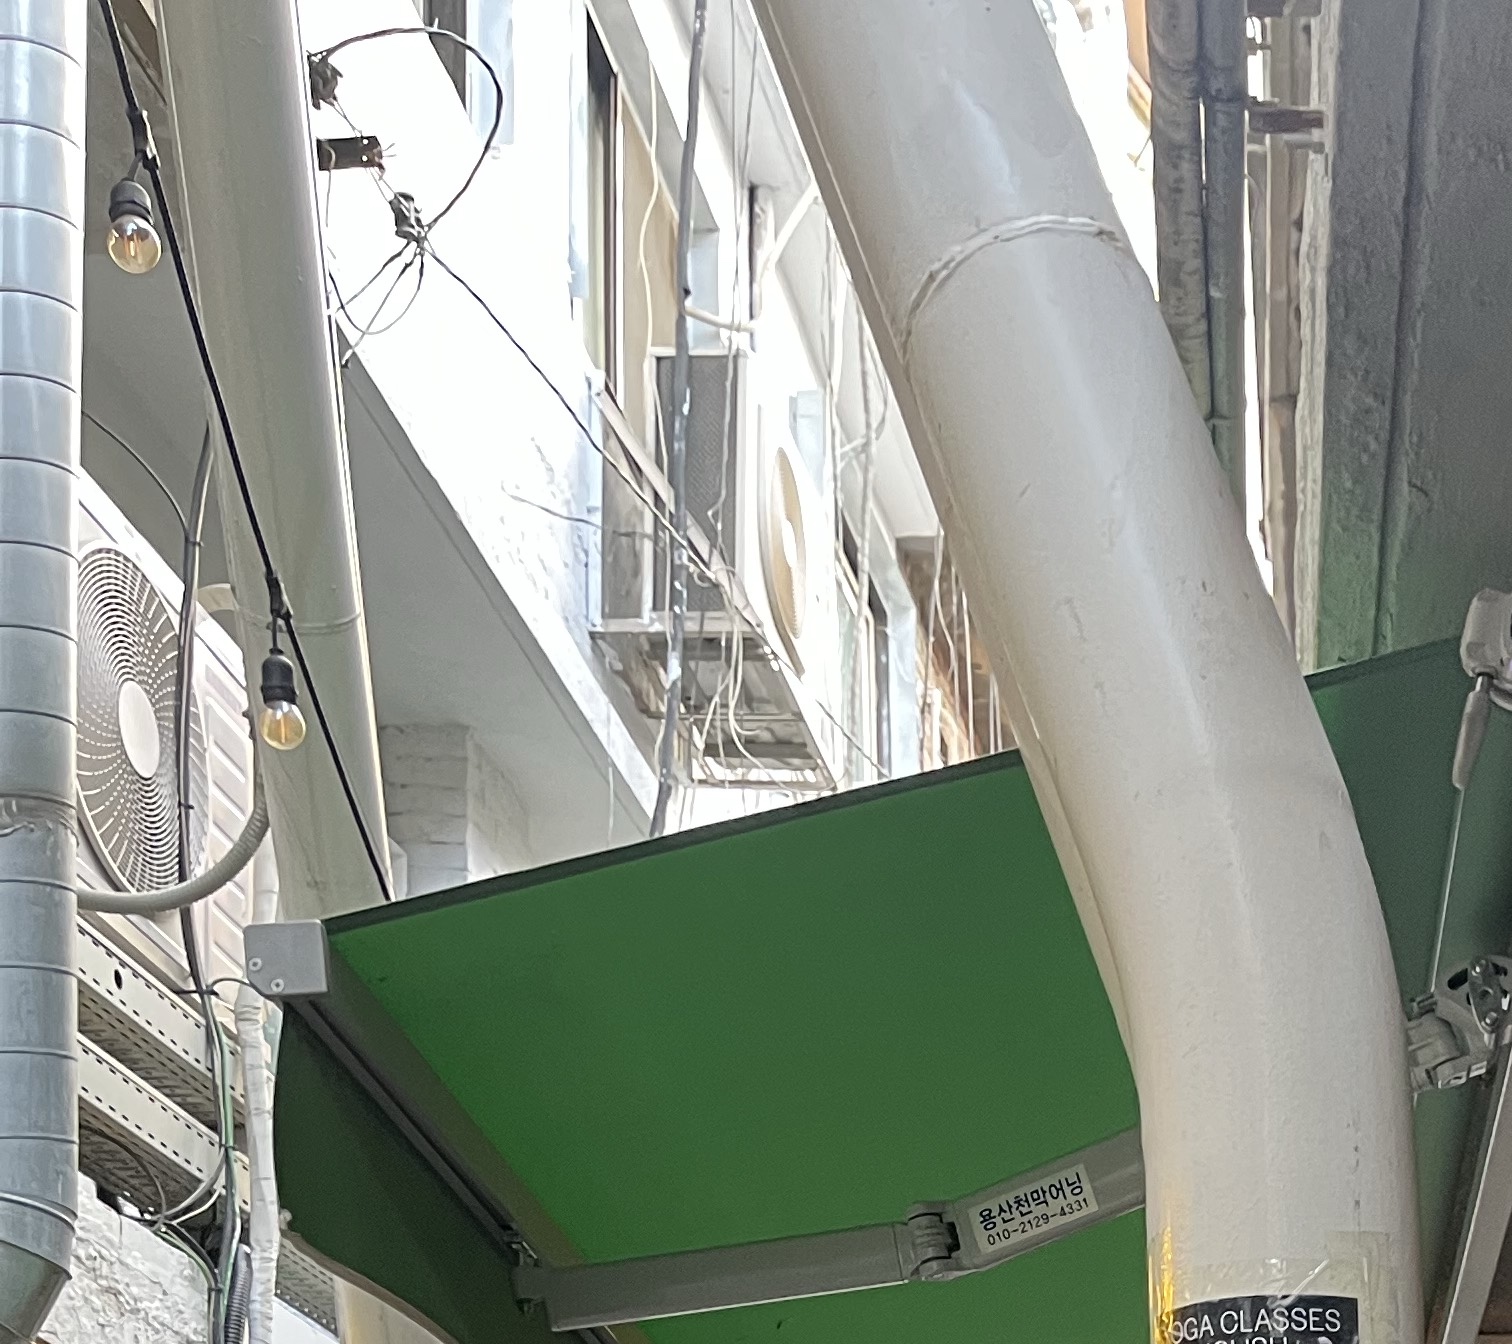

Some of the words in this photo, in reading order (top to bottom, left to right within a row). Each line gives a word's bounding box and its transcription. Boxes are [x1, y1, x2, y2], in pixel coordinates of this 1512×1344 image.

[979, 1171, 1084, 1232] 용산천막어닝
[987, 1197, 1090, 1246] 010-2129-4331
[1162, 1314, 1215, 1344] OGA
[1220, 1308, 1341, 1335] CLASSES
